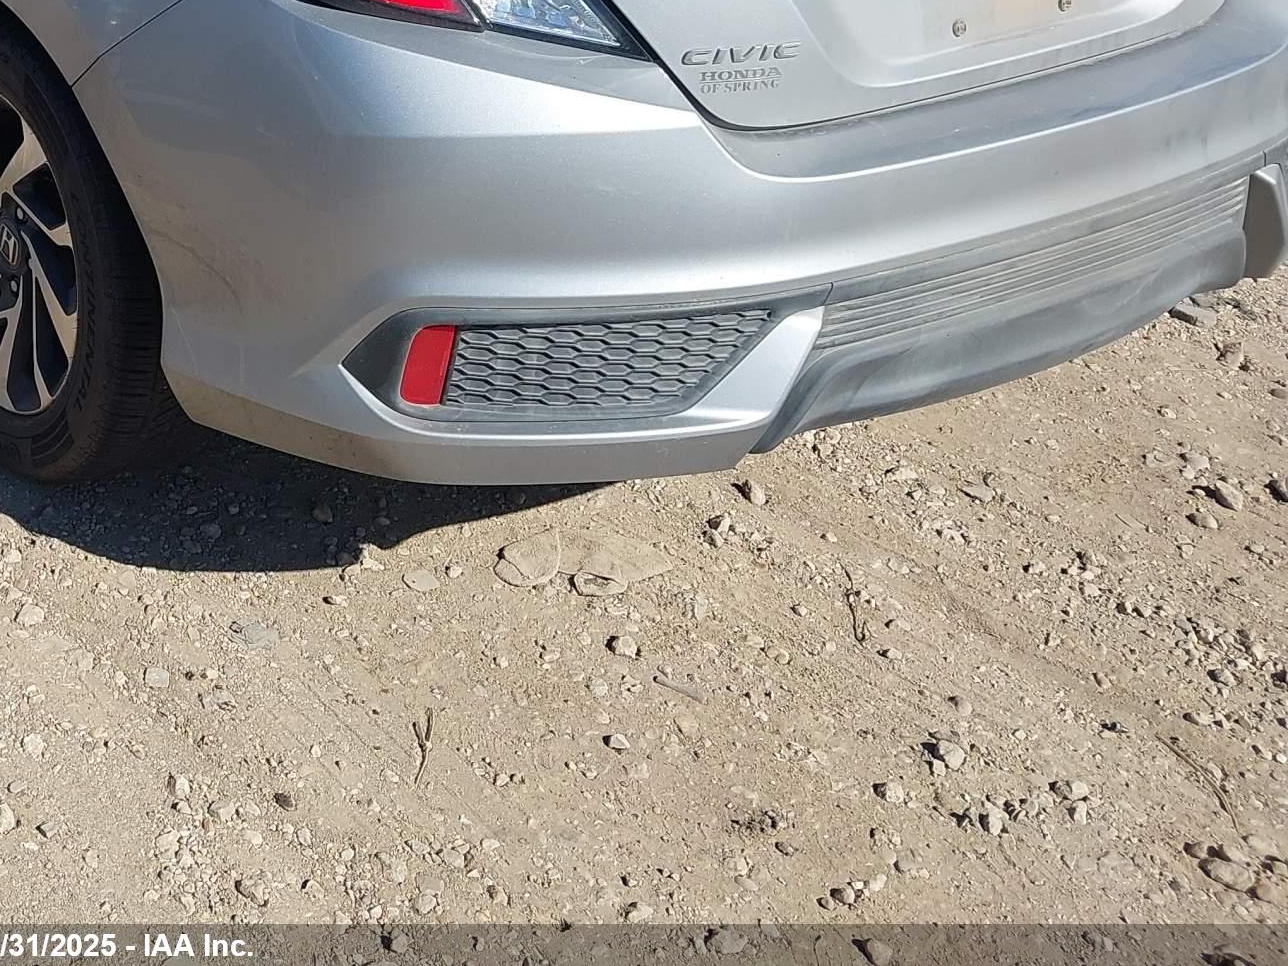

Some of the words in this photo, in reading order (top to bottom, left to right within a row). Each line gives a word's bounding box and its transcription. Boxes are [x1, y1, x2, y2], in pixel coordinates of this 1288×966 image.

[680, 40, 802, 66] CIVIC
[699, 66, 782, 82] HONDA
[699, 83, 721, 94] OF
[723, 79, 781, 94] SPRING
